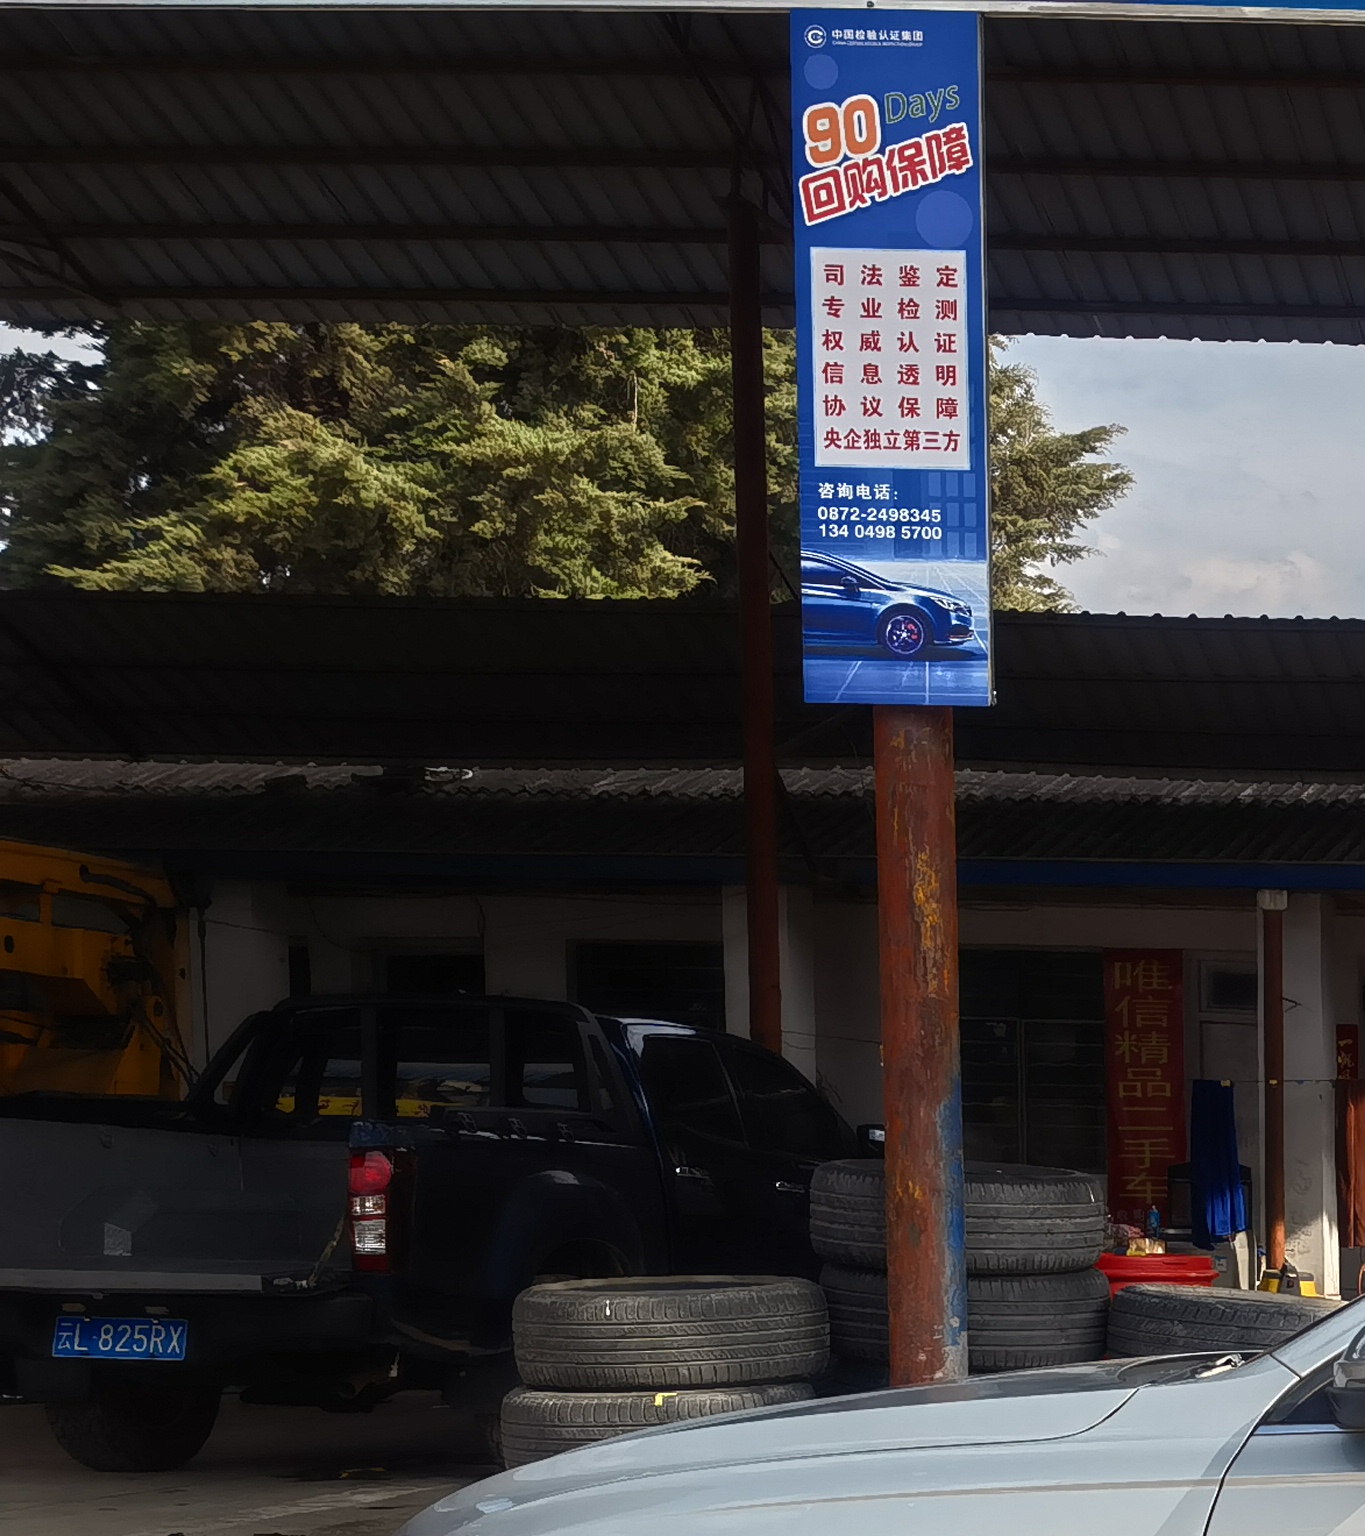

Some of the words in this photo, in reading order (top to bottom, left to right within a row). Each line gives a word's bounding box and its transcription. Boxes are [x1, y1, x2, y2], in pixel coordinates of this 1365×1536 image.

[832, 29, 923, 42] 中国检验认证集团
[803, 94, 881, 168] 90
[885, 85, 960, 124] Days
[800, 122, 974, 226] 回购保障
[823, 264, 958, 288] 司法鉴定
[822, 296, 958, 321] 专业检测
[822, 329, 957, 353] 权威认证
[822, 362, 957, 386] 信息透明
[823, 394, 960, 419] 协议保障
[823, 427, 961, 452] 央企独立第三方
[817, 507, 941, 523] 0872-2498345
[819, 524, 849, 538] 134
[854, 525, 896, 539] 0498
[901, 526, 942, 540] 5700
[1111, 959, 1176, 1205] 唯信精品二手车
